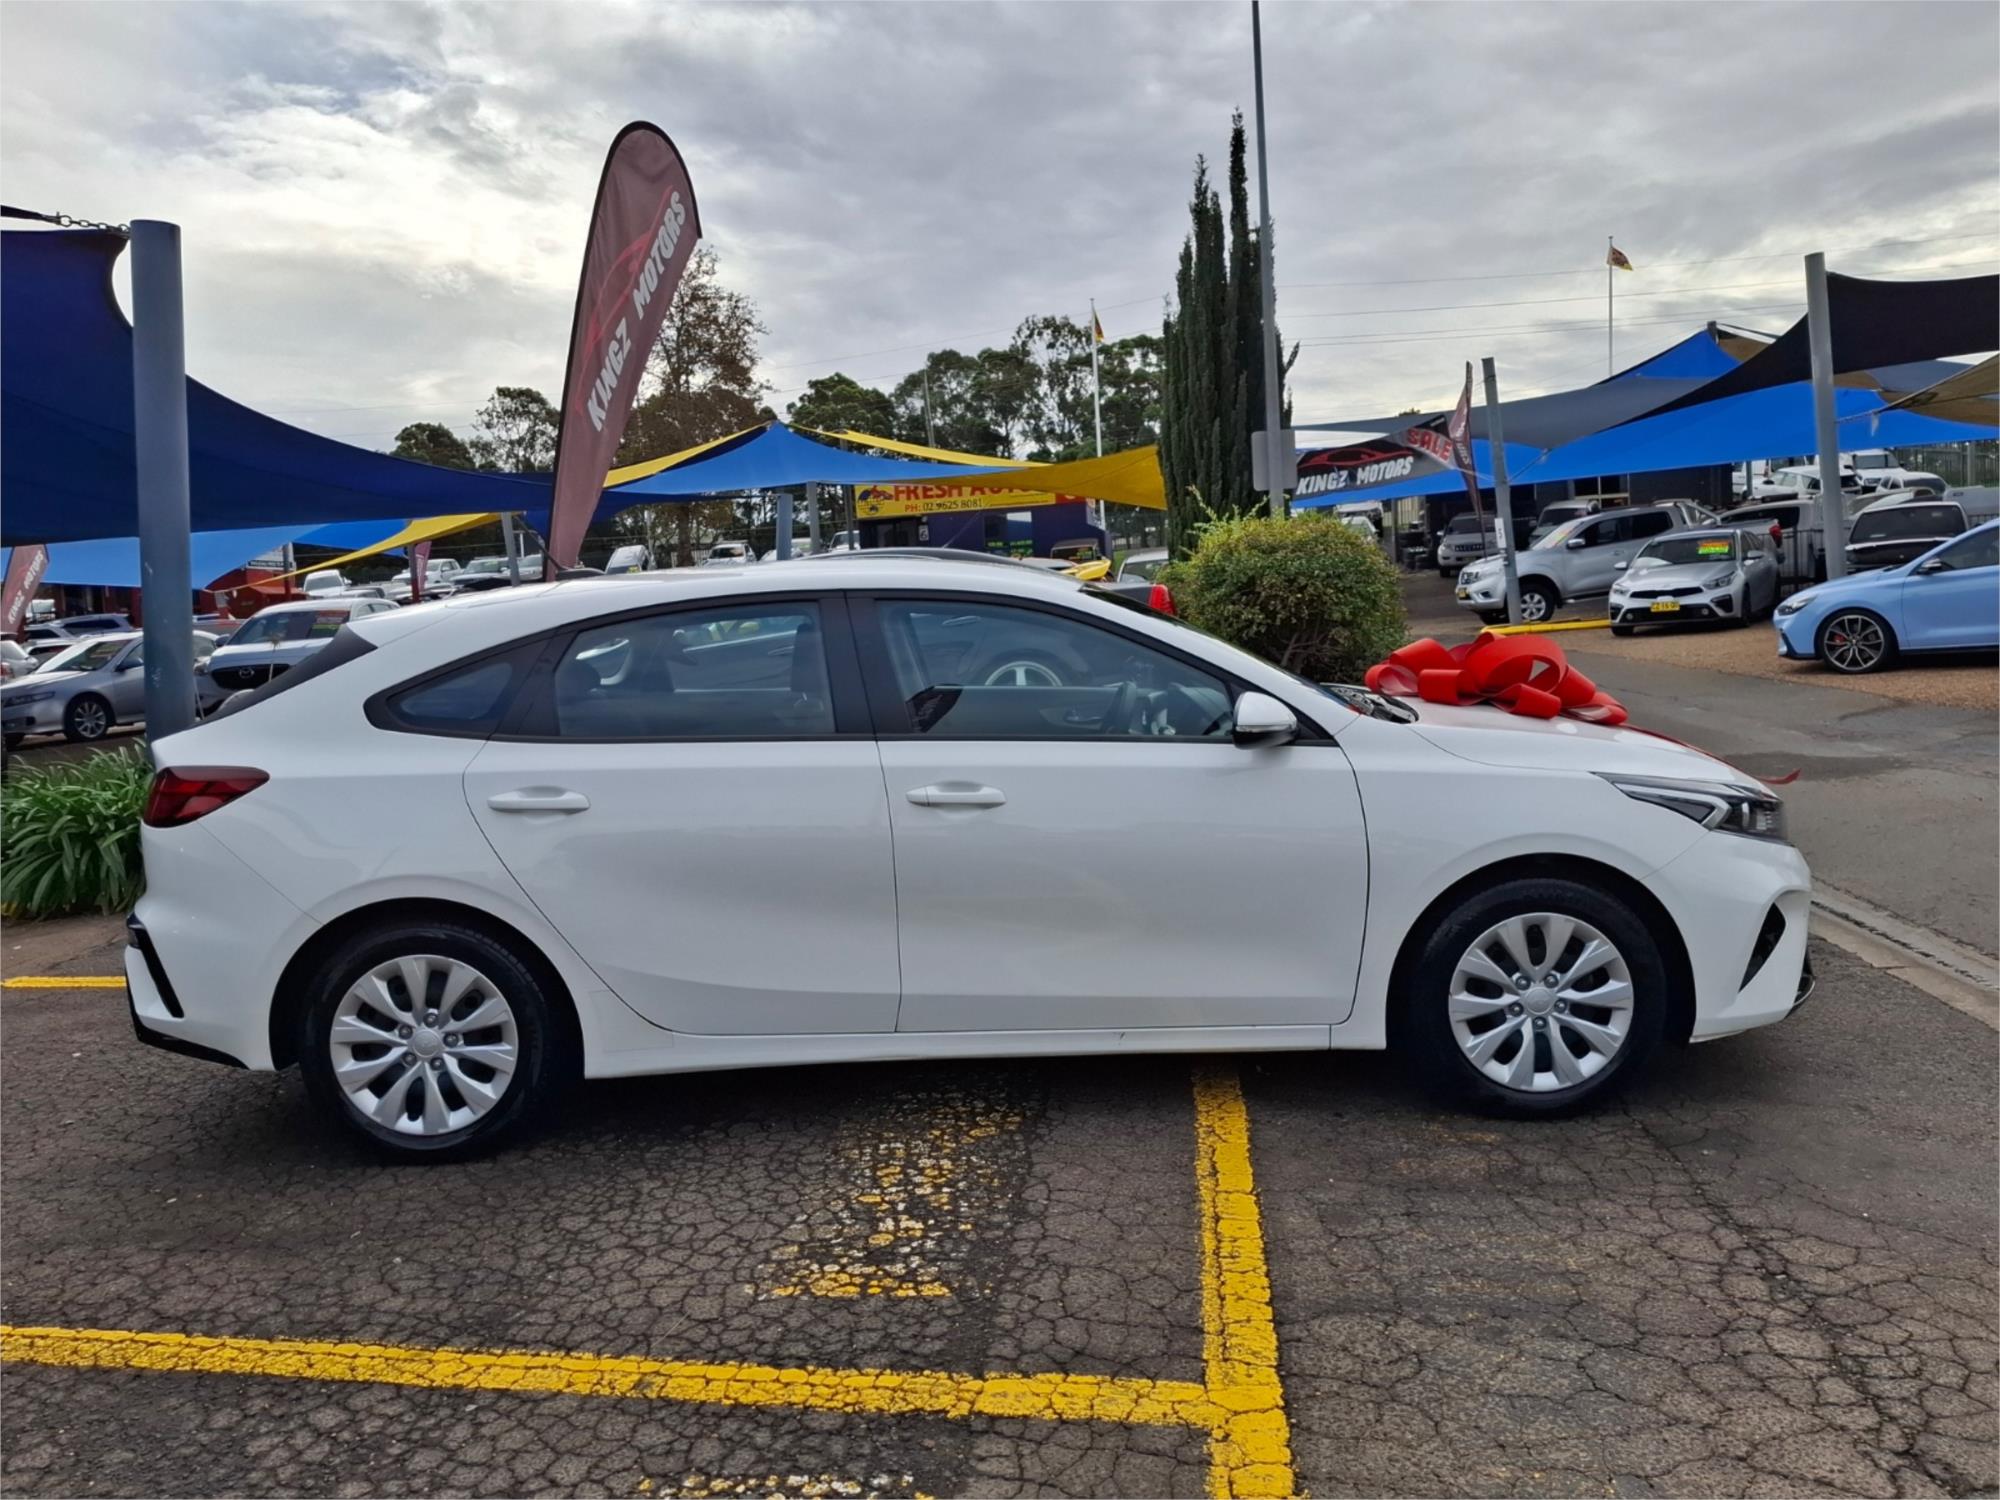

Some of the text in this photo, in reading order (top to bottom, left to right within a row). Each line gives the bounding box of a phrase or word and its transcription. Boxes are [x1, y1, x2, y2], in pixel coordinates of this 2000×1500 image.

[586, 190, 686, 432] KINGZ MOTORS
[1407, 427, 1453, 463] SALE
[894, 485, 963, 502] FRESH
[1296, 455, 1414, 496] KINGZ MOTORS
[904, 503, 921, 513] PH:
[923, 503, 934, 512] 02
[960, 498, 983, 509] 8081
